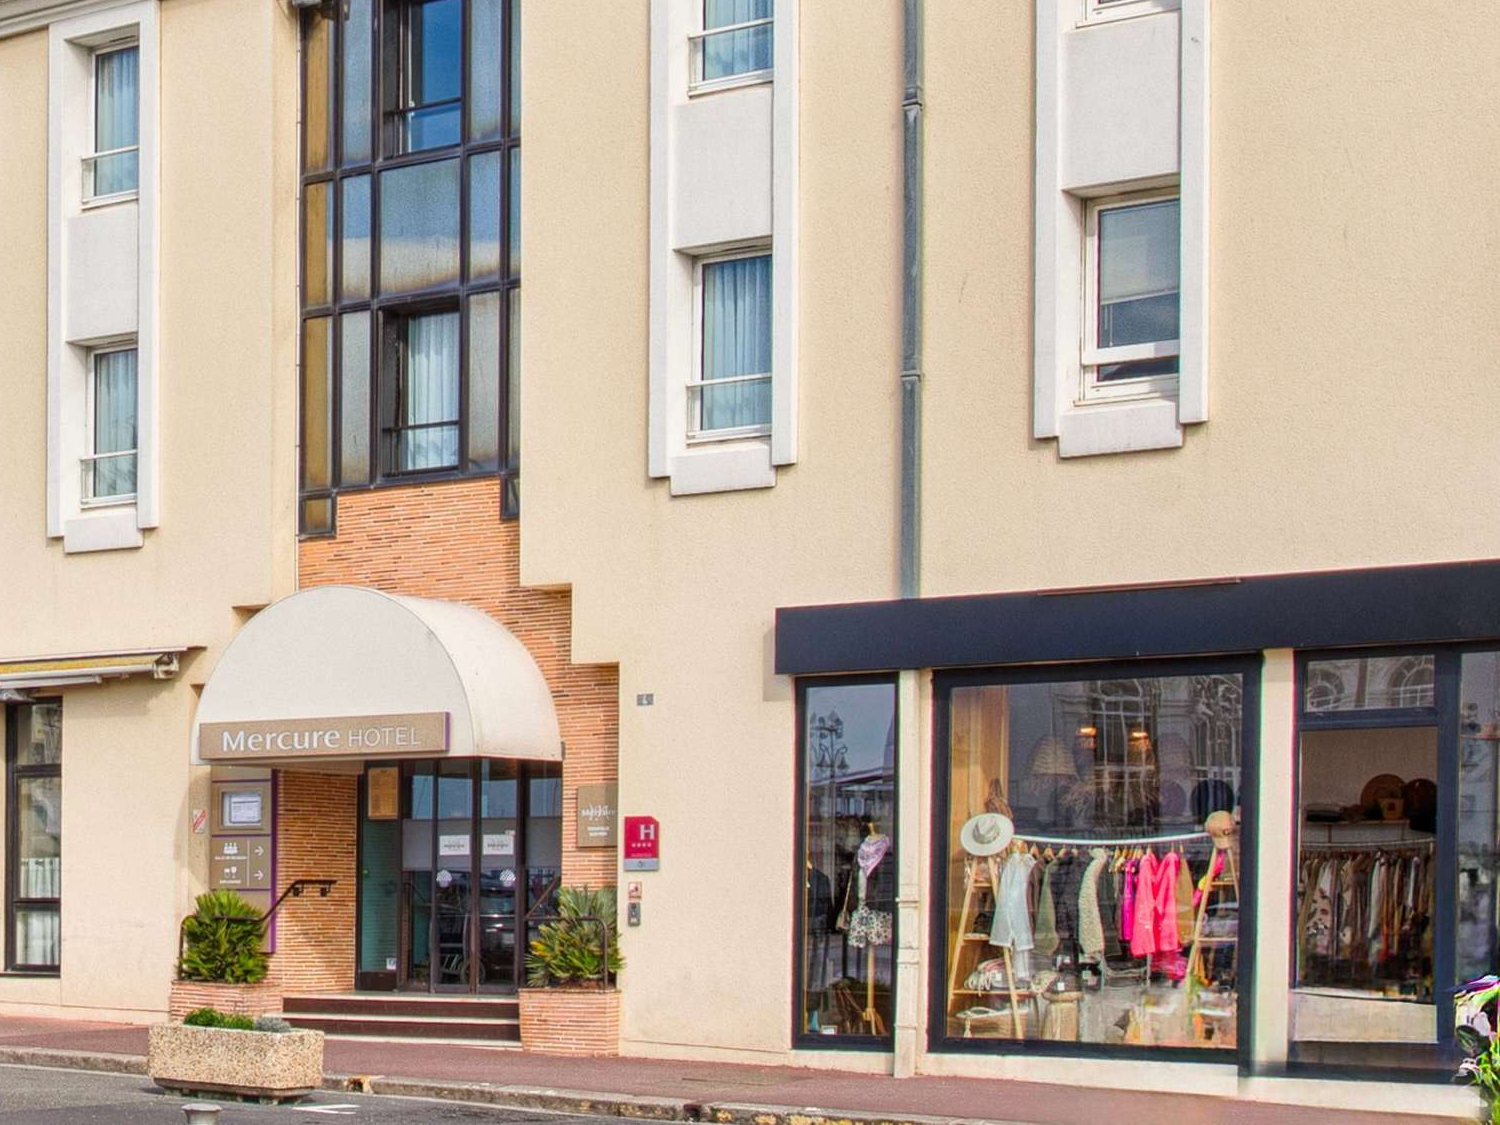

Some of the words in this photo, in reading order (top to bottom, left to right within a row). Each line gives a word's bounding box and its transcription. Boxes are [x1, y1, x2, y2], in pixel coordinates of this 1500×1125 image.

[222, 726, 341, 752] Mercure
[348, 726, 421, 748] HOTEL
[640, 824, 654, 840] H
